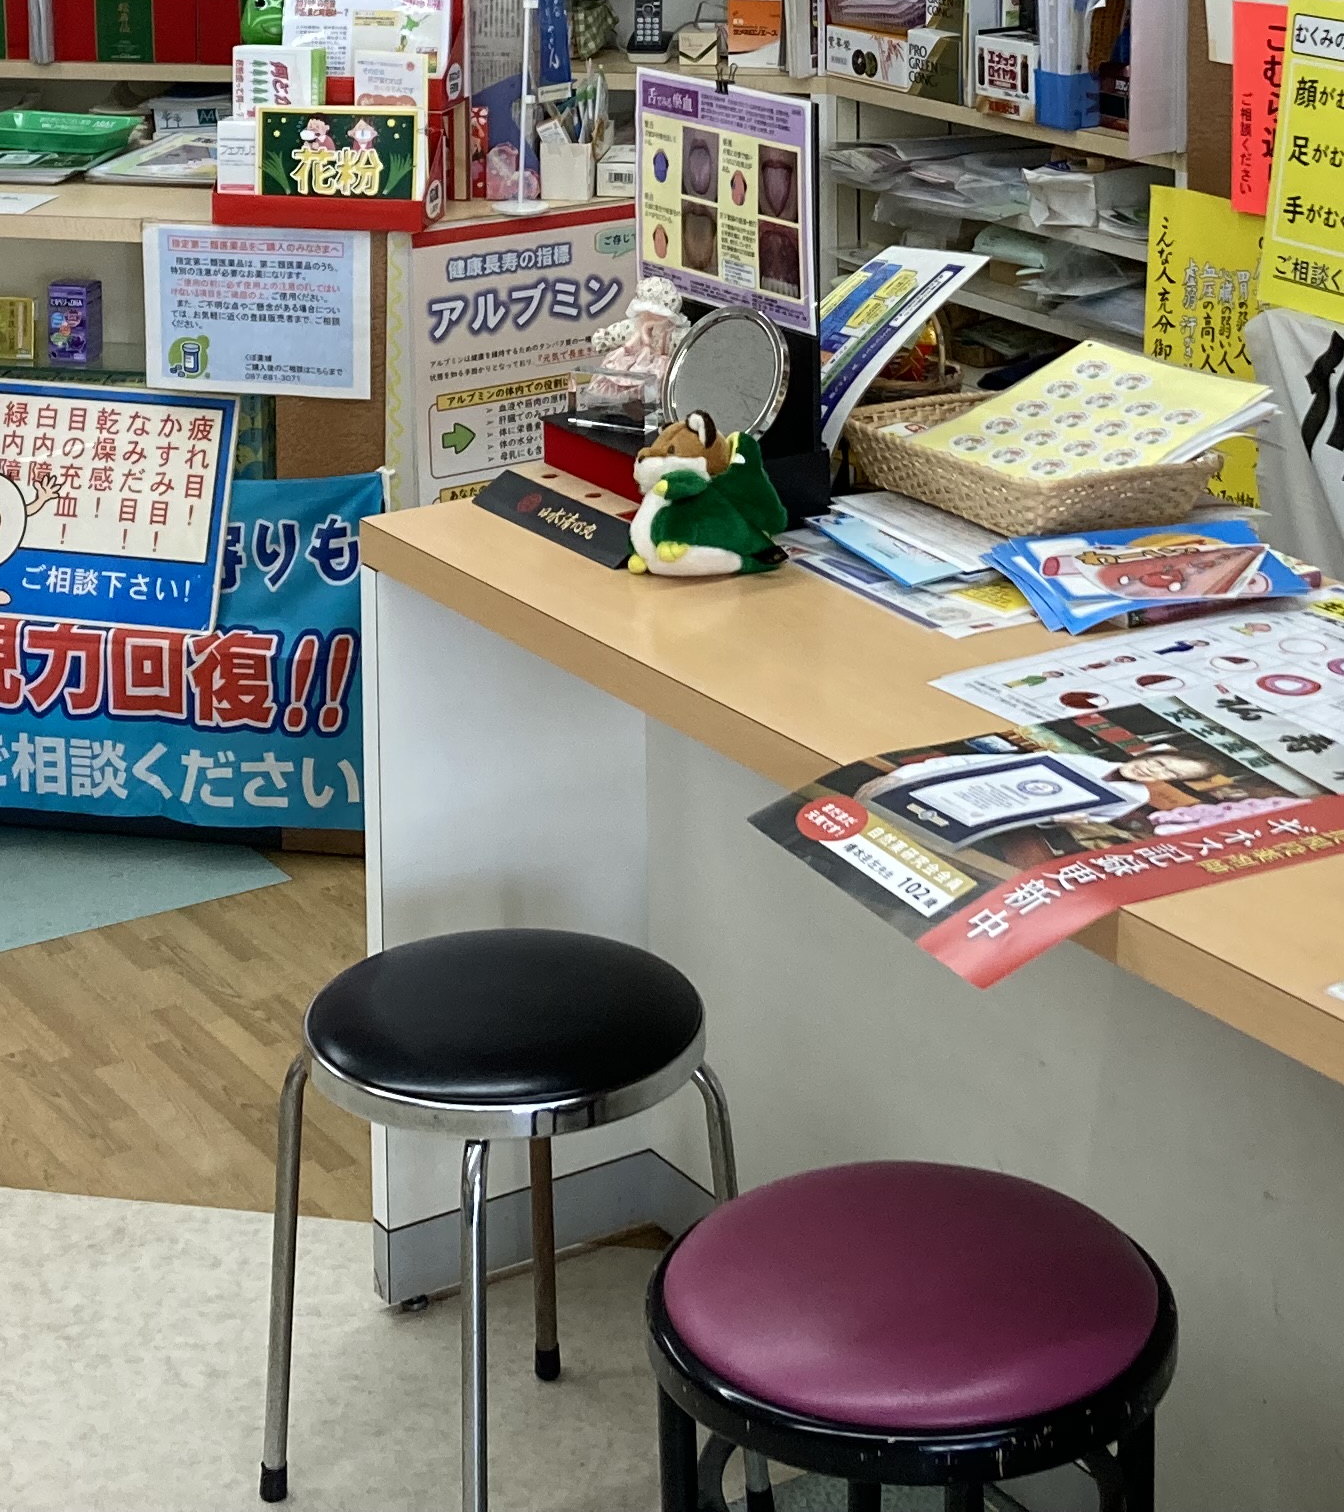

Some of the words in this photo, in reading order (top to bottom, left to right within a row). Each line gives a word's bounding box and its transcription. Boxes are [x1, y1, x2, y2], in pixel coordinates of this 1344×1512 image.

[909, 44, 927, 57] PRO
[909, 57, 939, 73] GREEN
[291, 146, 383, 197] 花粉
[447, 245, 572, 281] 健康長寿の指標
[429, 275, 622, 341] アルブミン
[0, 401, 28, 482] 緑内障
[28, 403, 58, 482] 白内障
